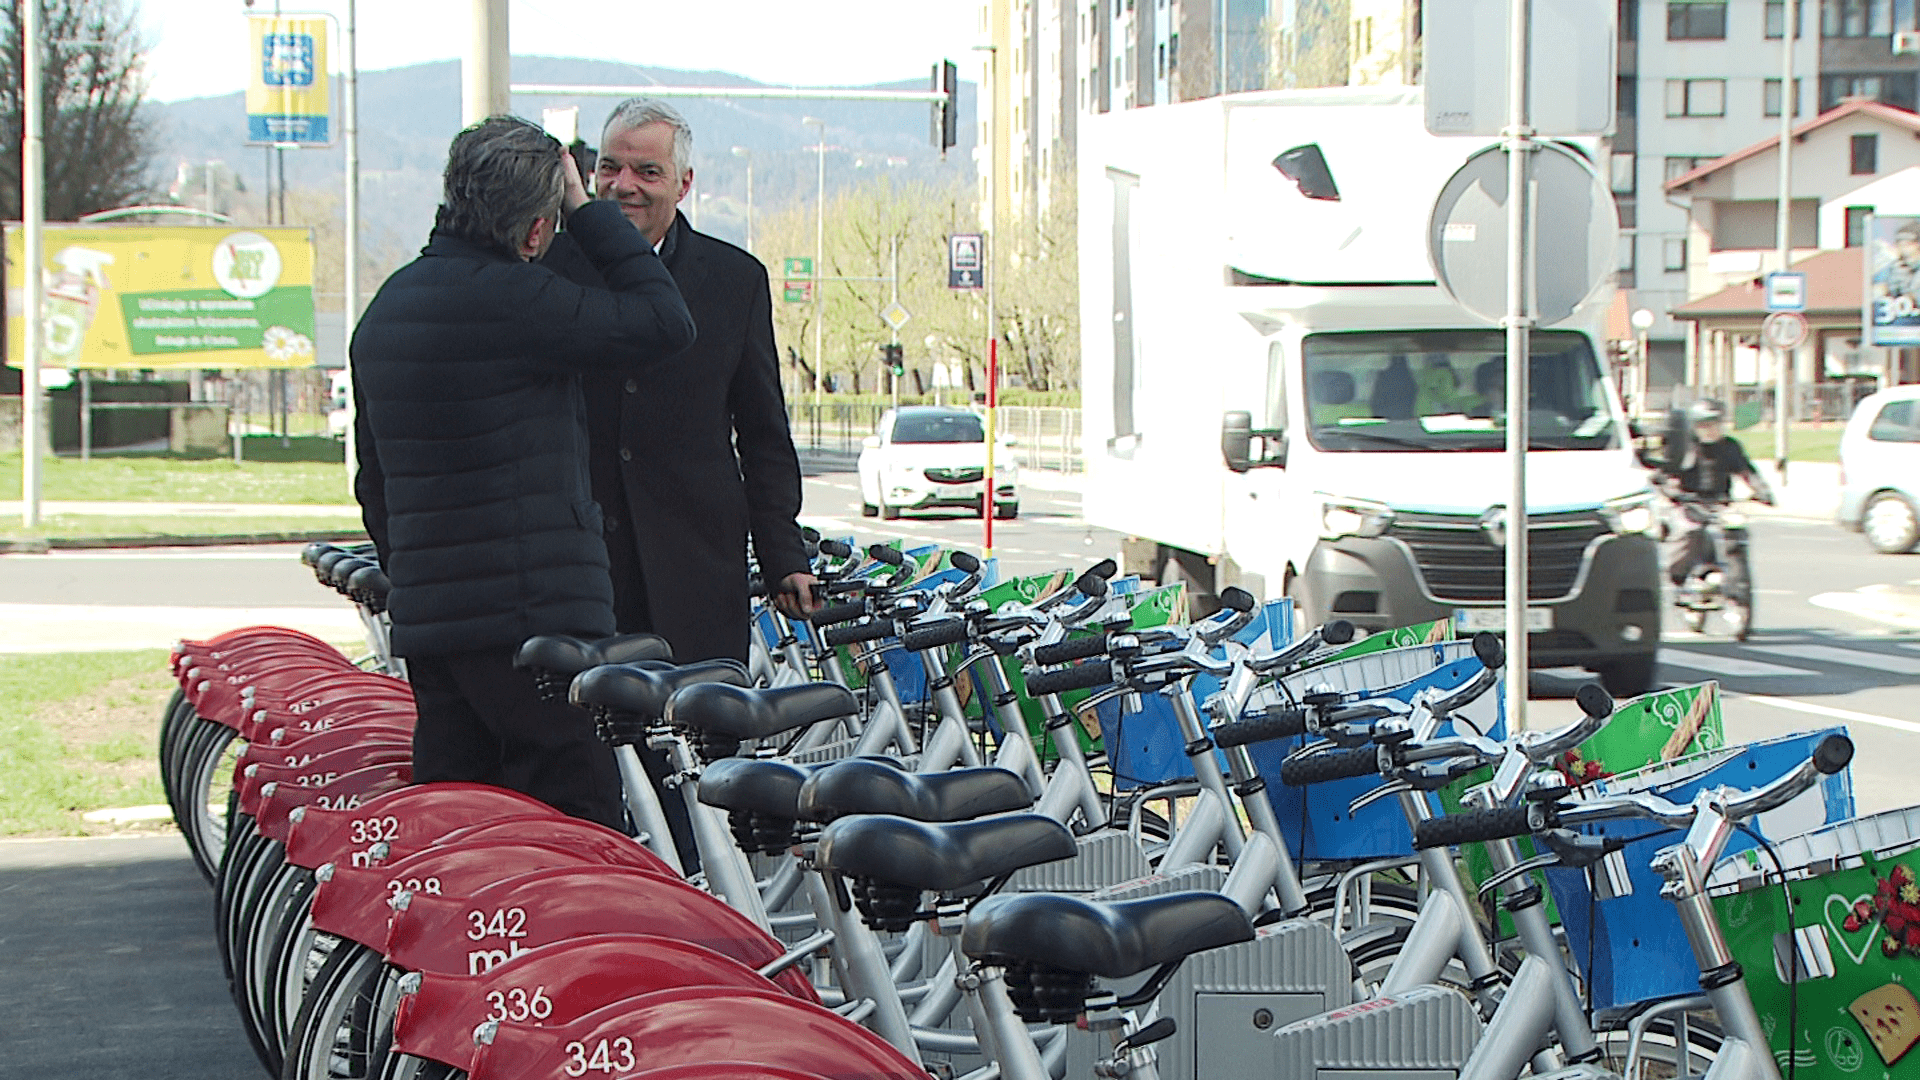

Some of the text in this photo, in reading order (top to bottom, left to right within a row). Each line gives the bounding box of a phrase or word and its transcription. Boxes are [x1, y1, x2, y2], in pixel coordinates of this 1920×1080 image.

[351, 816, 399, 843] 332
[467, 907, 528, 941] 342
[485, 986, 553, 1022] 336
[564, 1036, 637, 1077] 343
